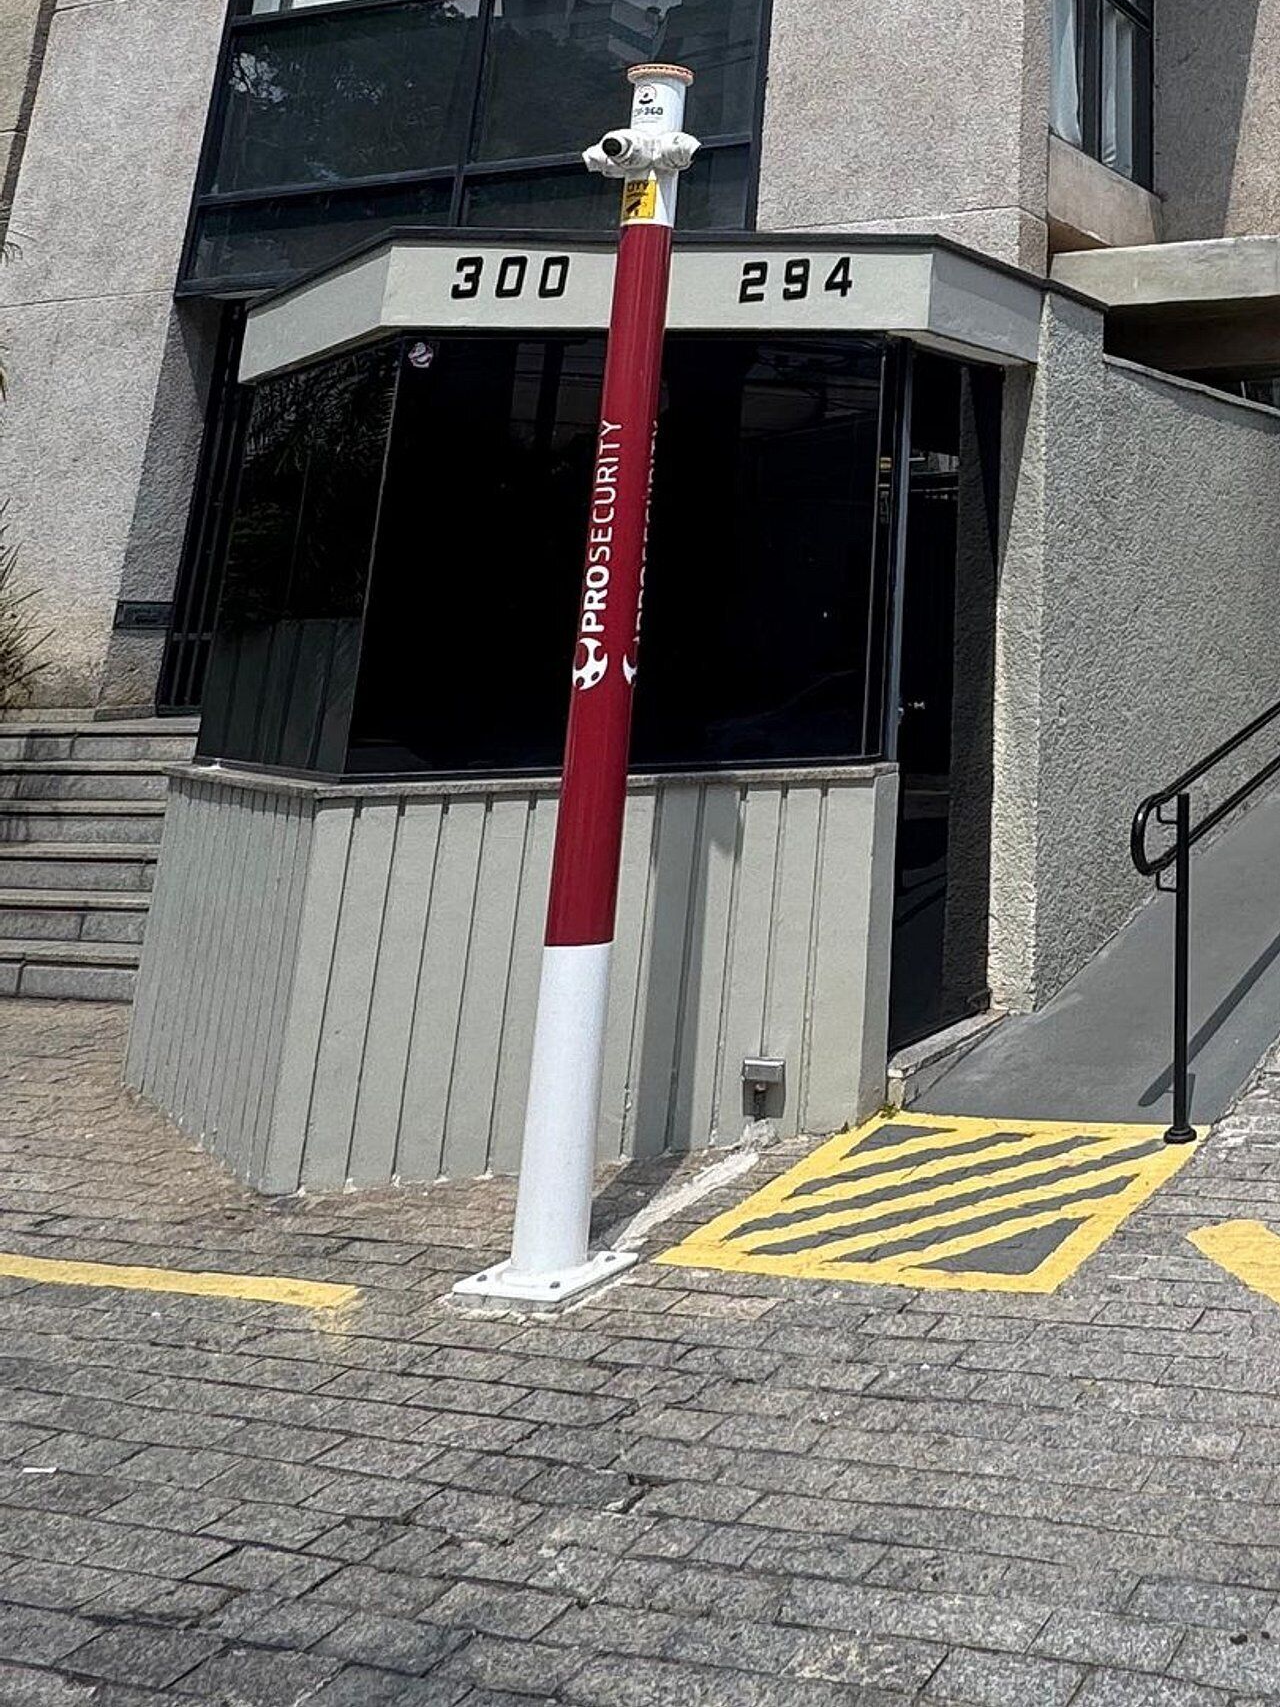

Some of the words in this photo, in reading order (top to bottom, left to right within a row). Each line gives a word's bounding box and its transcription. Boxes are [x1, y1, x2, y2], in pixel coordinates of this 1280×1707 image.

[450, 255, 571, 300] 300
[738, 256, 854, 304] 294
[580, 420, 622, 634] PROSECURITY
